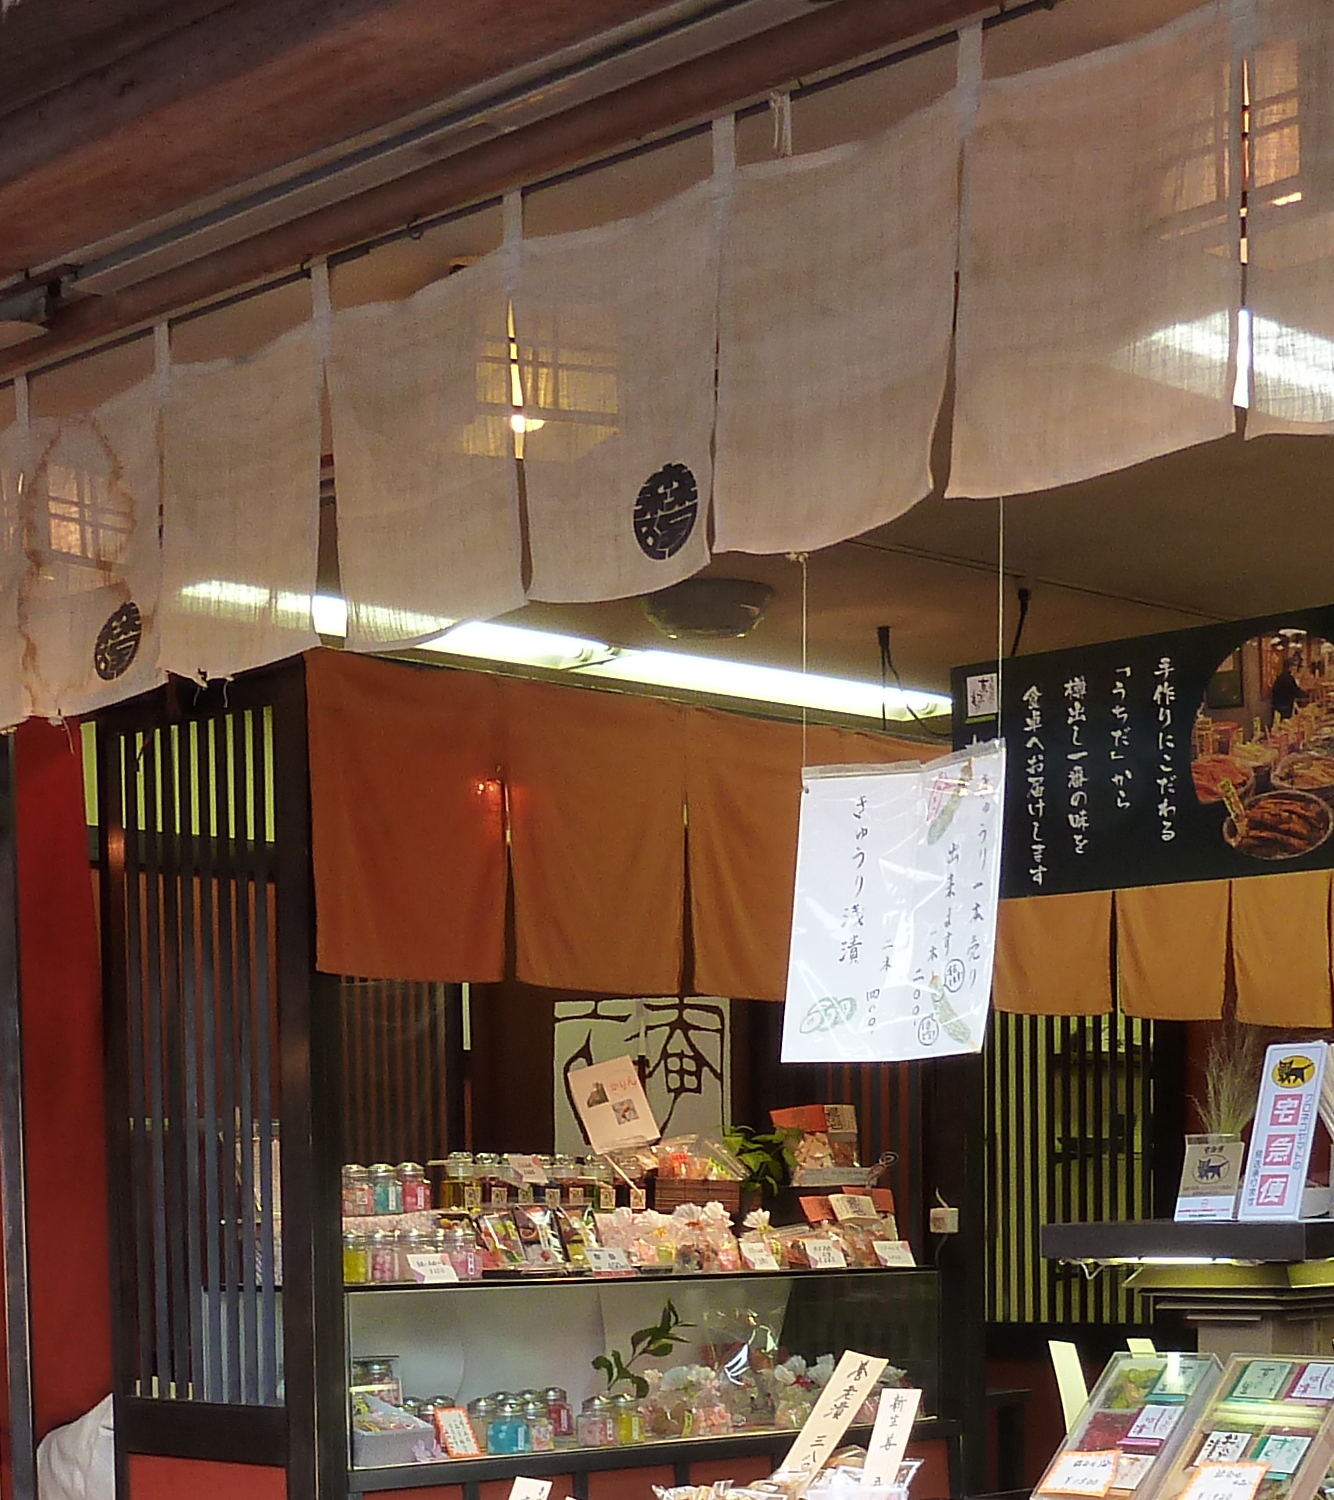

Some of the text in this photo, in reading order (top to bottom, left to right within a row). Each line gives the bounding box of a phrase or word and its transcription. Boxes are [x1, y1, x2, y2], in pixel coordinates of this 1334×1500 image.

[1021, 685, 1048, 887] 食卓へお届けします
[1110, 665, 1133, 810] 「うちだ」から
[1152, 656, 1178, 842] 手作りにこだわる
[838, 794, 869, 964] きゅうり浅漬
[1257, 1096, 1302, 1205] 宅急便
